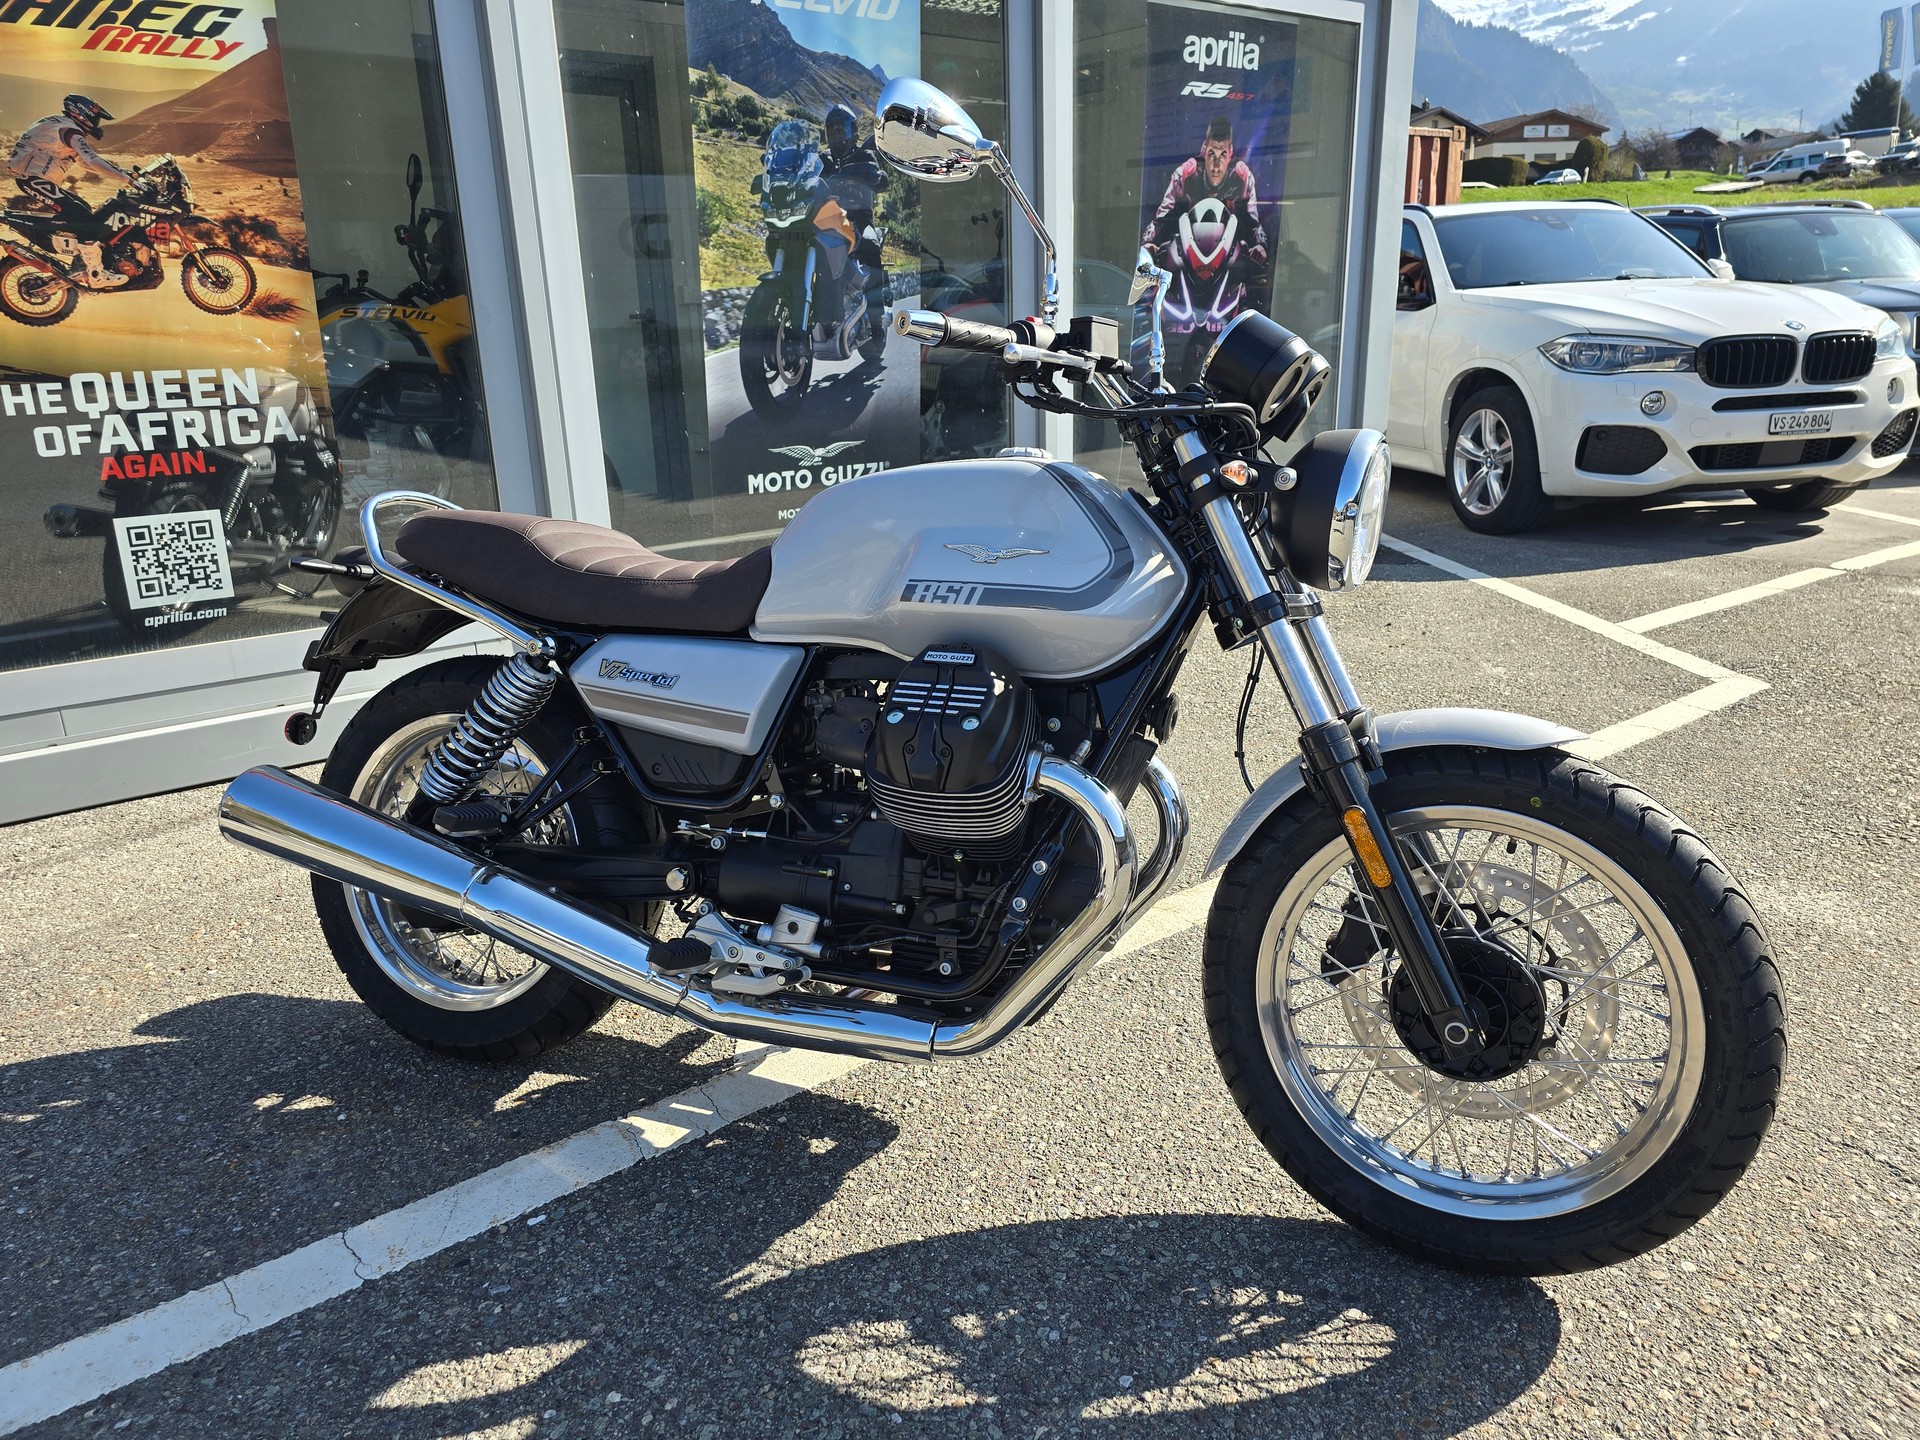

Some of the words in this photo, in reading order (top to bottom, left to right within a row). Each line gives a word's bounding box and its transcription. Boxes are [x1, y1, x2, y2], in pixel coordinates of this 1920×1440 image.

[0, 0, 244, 40] AREG
[81, 24, 245, 61] RALLY
[1183, 30, 1260, 72] aprilia
[1181, 81, 1233, 99] RS
[1226, 92, 1256, 101] 457
[339, 306, 437, 322] STELVIO
[69, 367, 261, 419] QUEEN
[33, 423, 92, 458] OF
[99, 406, 306, 454] AFRICA.
[100, 450, 217, 481] AGAIN.
[747, 469, 813, 495] MOTO
[911, 582, 985, 605] 850
[144, 607, 227, 627] aprilia.com
[599, 658, 629, 679] V7
[619, 667, 680, 689] Special
